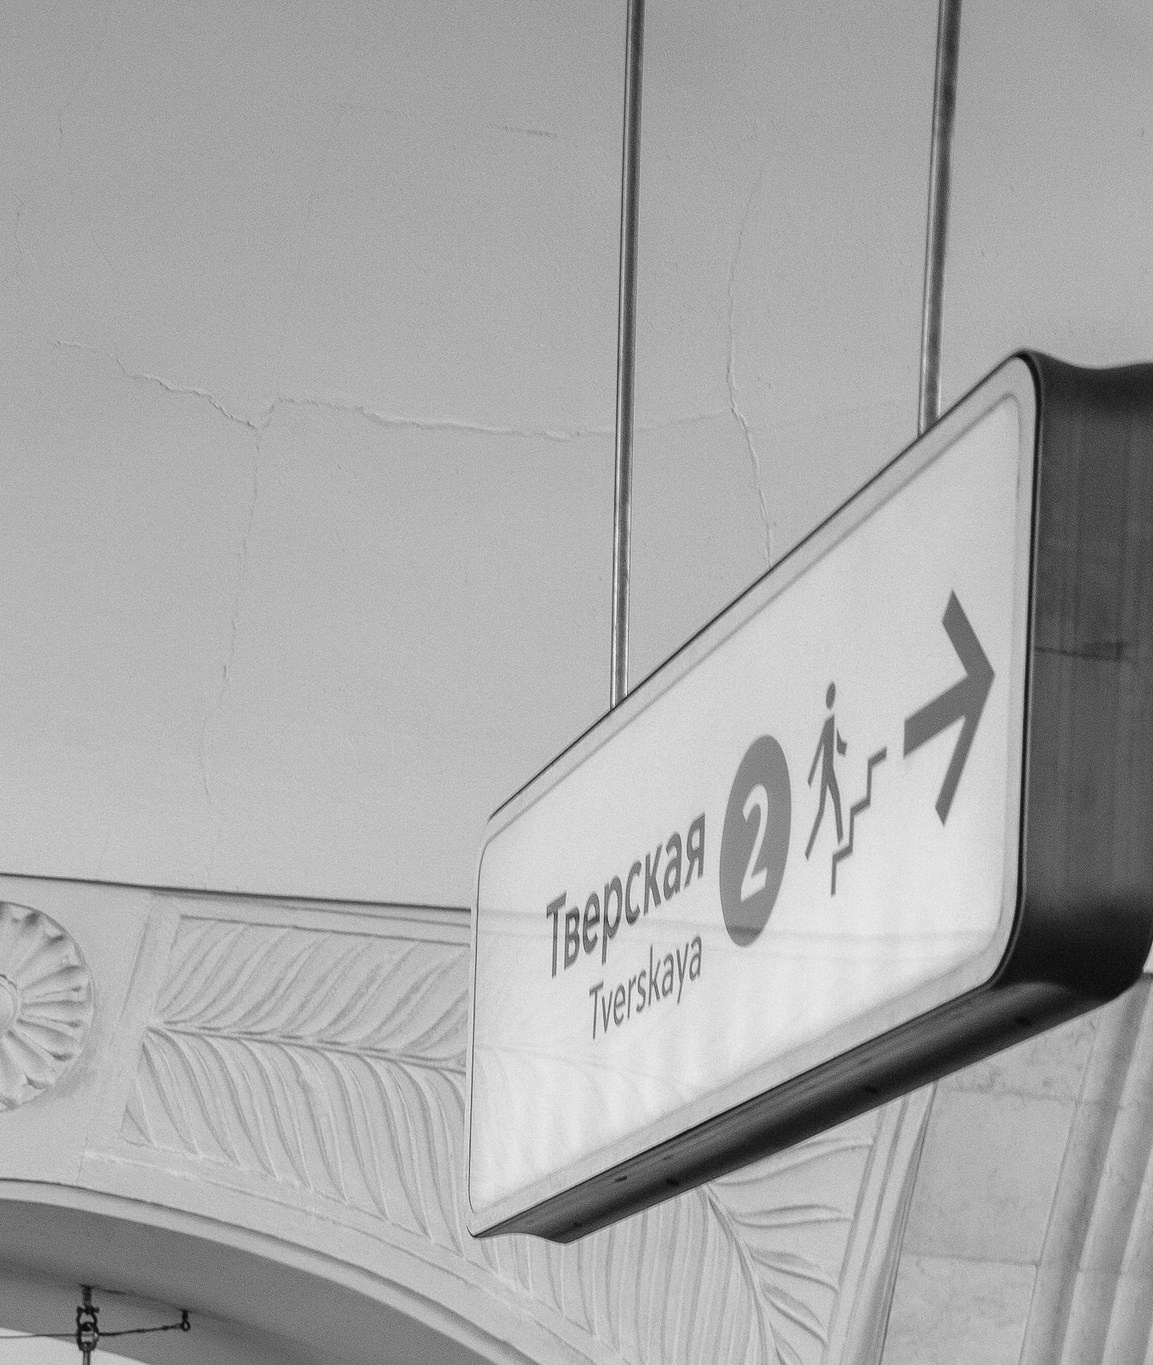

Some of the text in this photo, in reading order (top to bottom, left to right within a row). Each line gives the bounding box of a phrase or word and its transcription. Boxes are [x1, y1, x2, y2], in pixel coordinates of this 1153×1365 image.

[546, 783, 768, 979] Тверская 2
[589, 934, 703, 1040] Tverskaya
